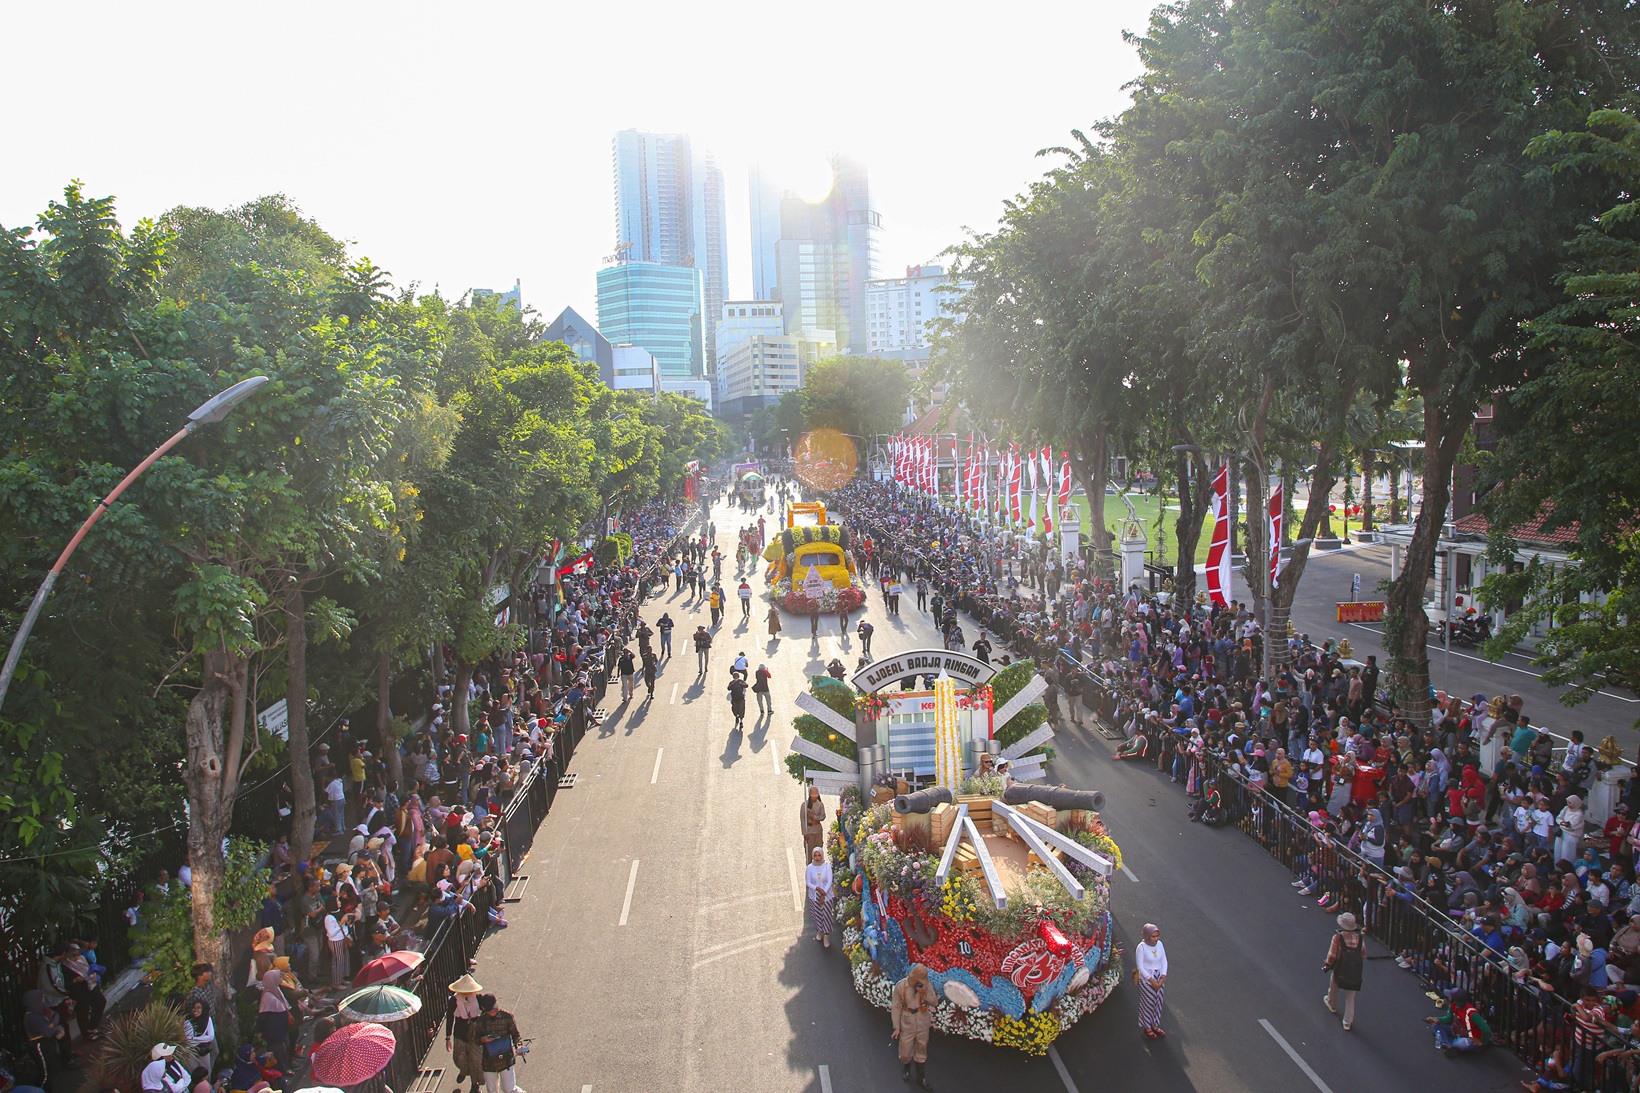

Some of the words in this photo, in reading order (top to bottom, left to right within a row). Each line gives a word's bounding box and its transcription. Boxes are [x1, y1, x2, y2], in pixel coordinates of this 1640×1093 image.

[866, 661, 904, 685] DJOEAL
[907, 656, 940, 669] BADJA
[944, 658, 980, 679] RINGAN
[958, 940, 971, 955] 10
